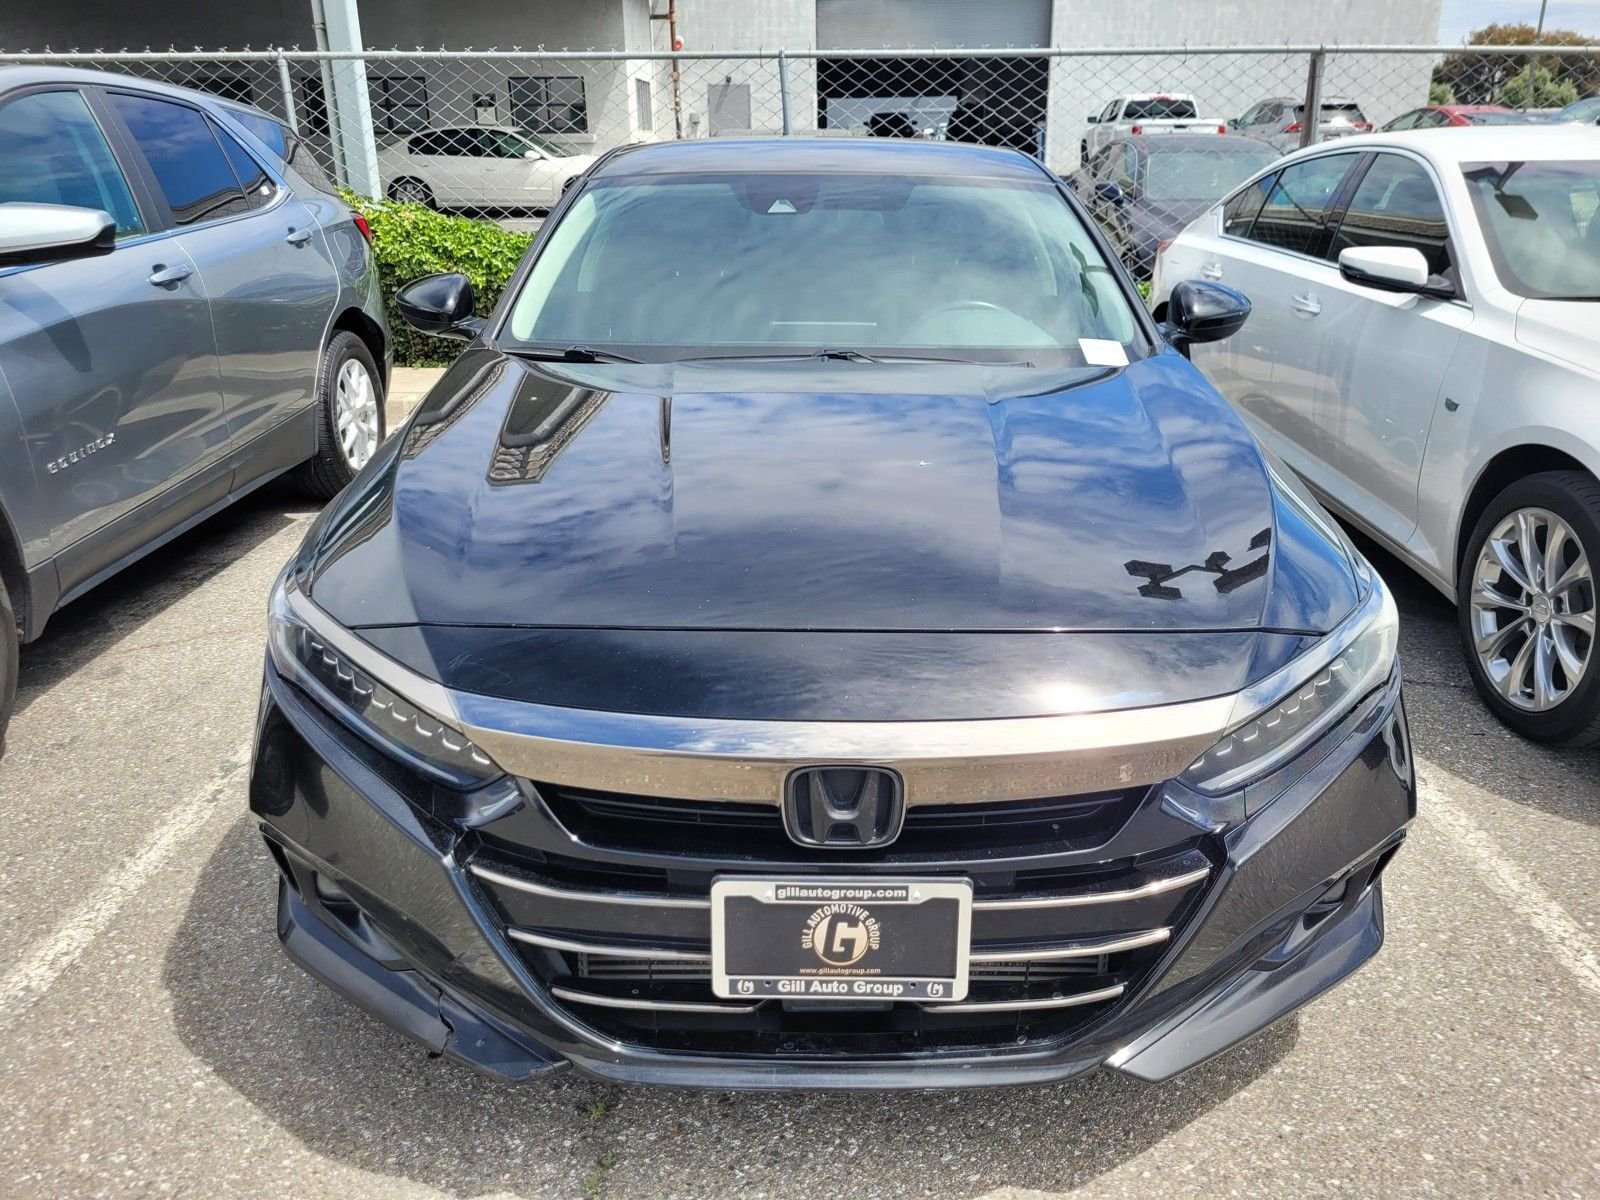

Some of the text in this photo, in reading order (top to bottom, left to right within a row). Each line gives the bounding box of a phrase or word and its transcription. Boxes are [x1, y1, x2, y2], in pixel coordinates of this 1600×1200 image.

[47, 432, 115, 474] EQUINOX
[777, 886, 907, 900] gillautogroup.com
[801, 903, 881, 951] GILL AUTOMOTIVE GROUP
[799, 967, 881, 975] www.gillautogroup.com
[777, 980, 806, 993] Gill
[809, 980, 848, 993] Auto
[853, 980, 904, 996] Group
